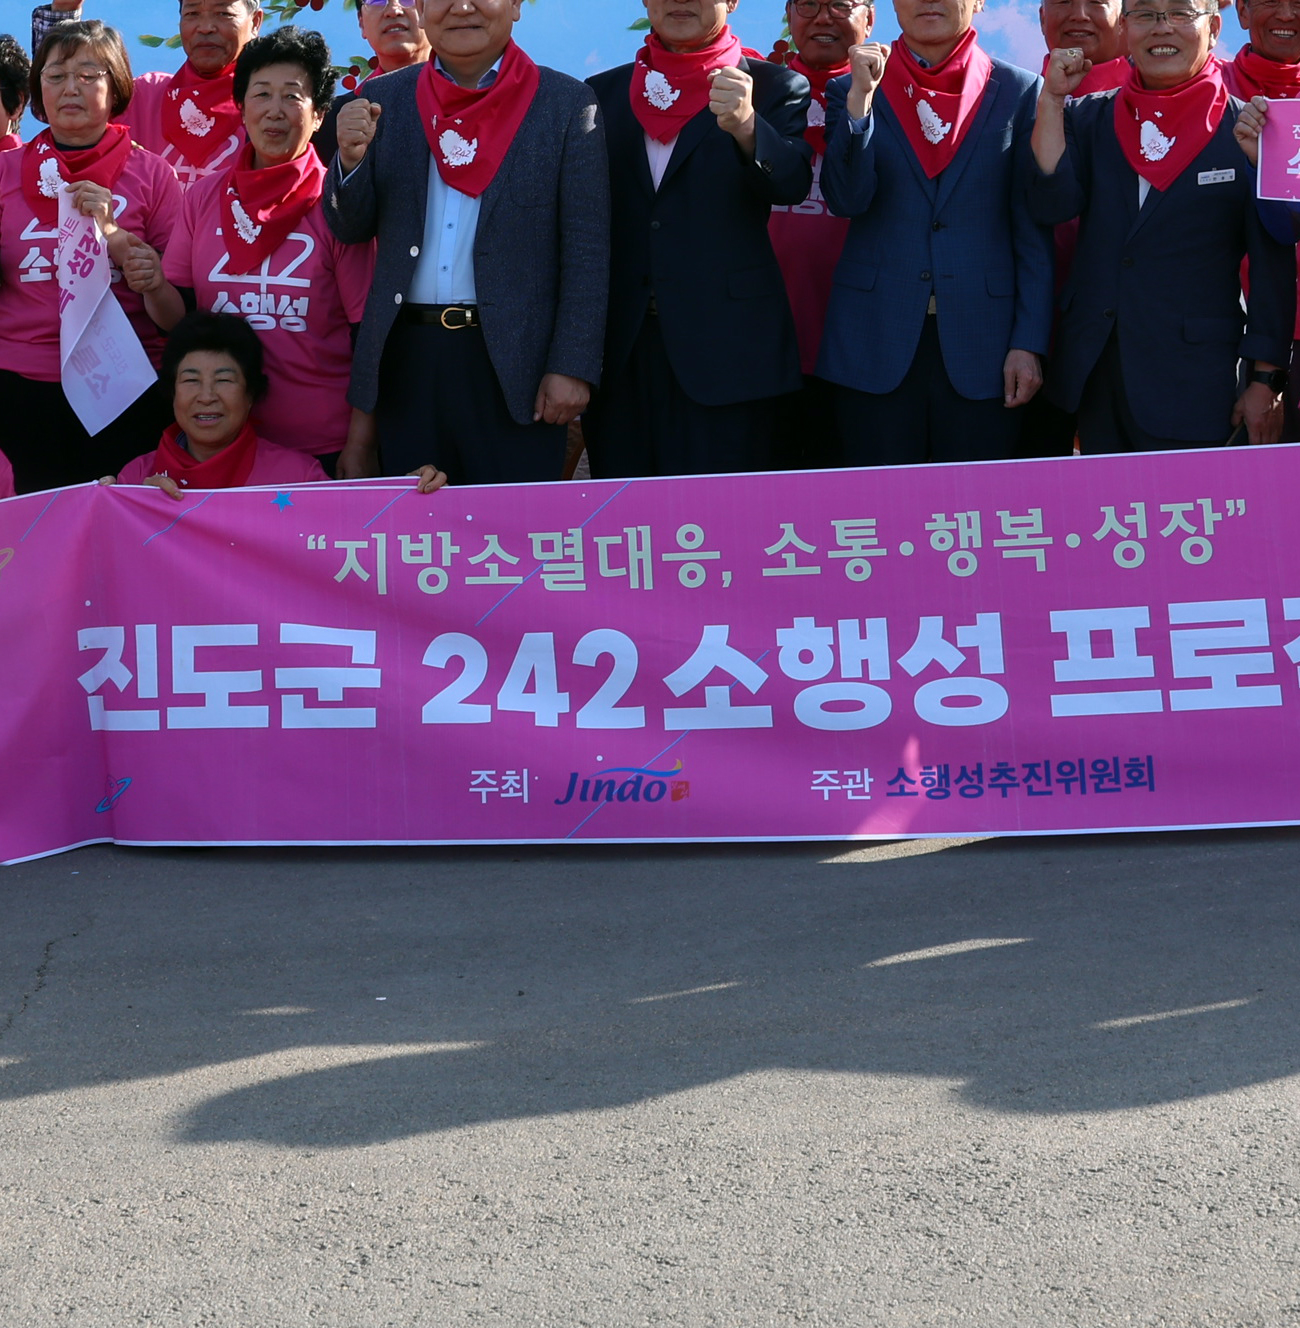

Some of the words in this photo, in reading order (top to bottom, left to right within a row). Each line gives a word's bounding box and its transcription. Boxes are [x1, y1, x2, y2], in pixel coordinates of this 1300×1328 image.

[456, 147, 471, 157] 242
[77, 623, 381, 731] 진도군
[468, 768, 529, 804] 주최
[554, 772, 667, 805] Jindo
[810, 768, 874, 800] 주관
[885, 755, 1155, 800] 소행성추진위원회
